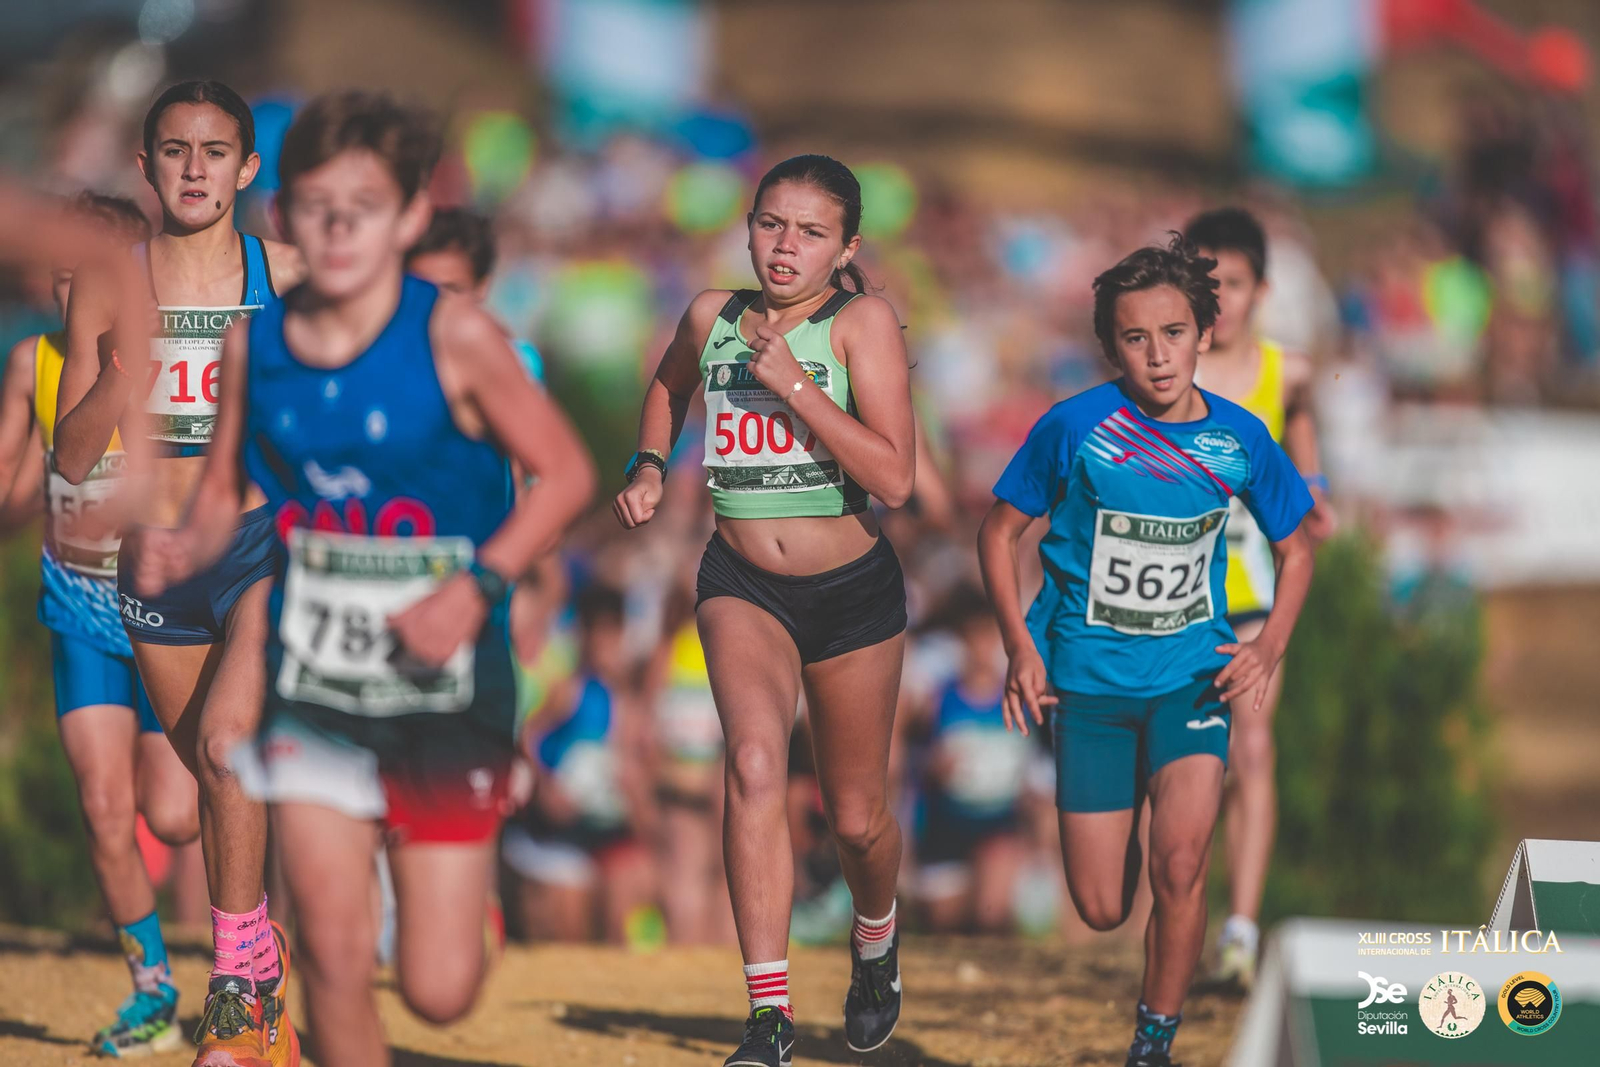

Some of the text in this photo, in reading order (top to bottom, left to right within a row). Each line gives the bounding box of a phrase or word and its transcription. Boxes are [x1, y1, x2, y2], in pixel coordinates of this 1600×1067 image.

[163, 312, 234, 330] ITÁLICA
[1139, 520, 1200, 539] ITÁLICA
[1104, 553, 1206, 601] 5622
